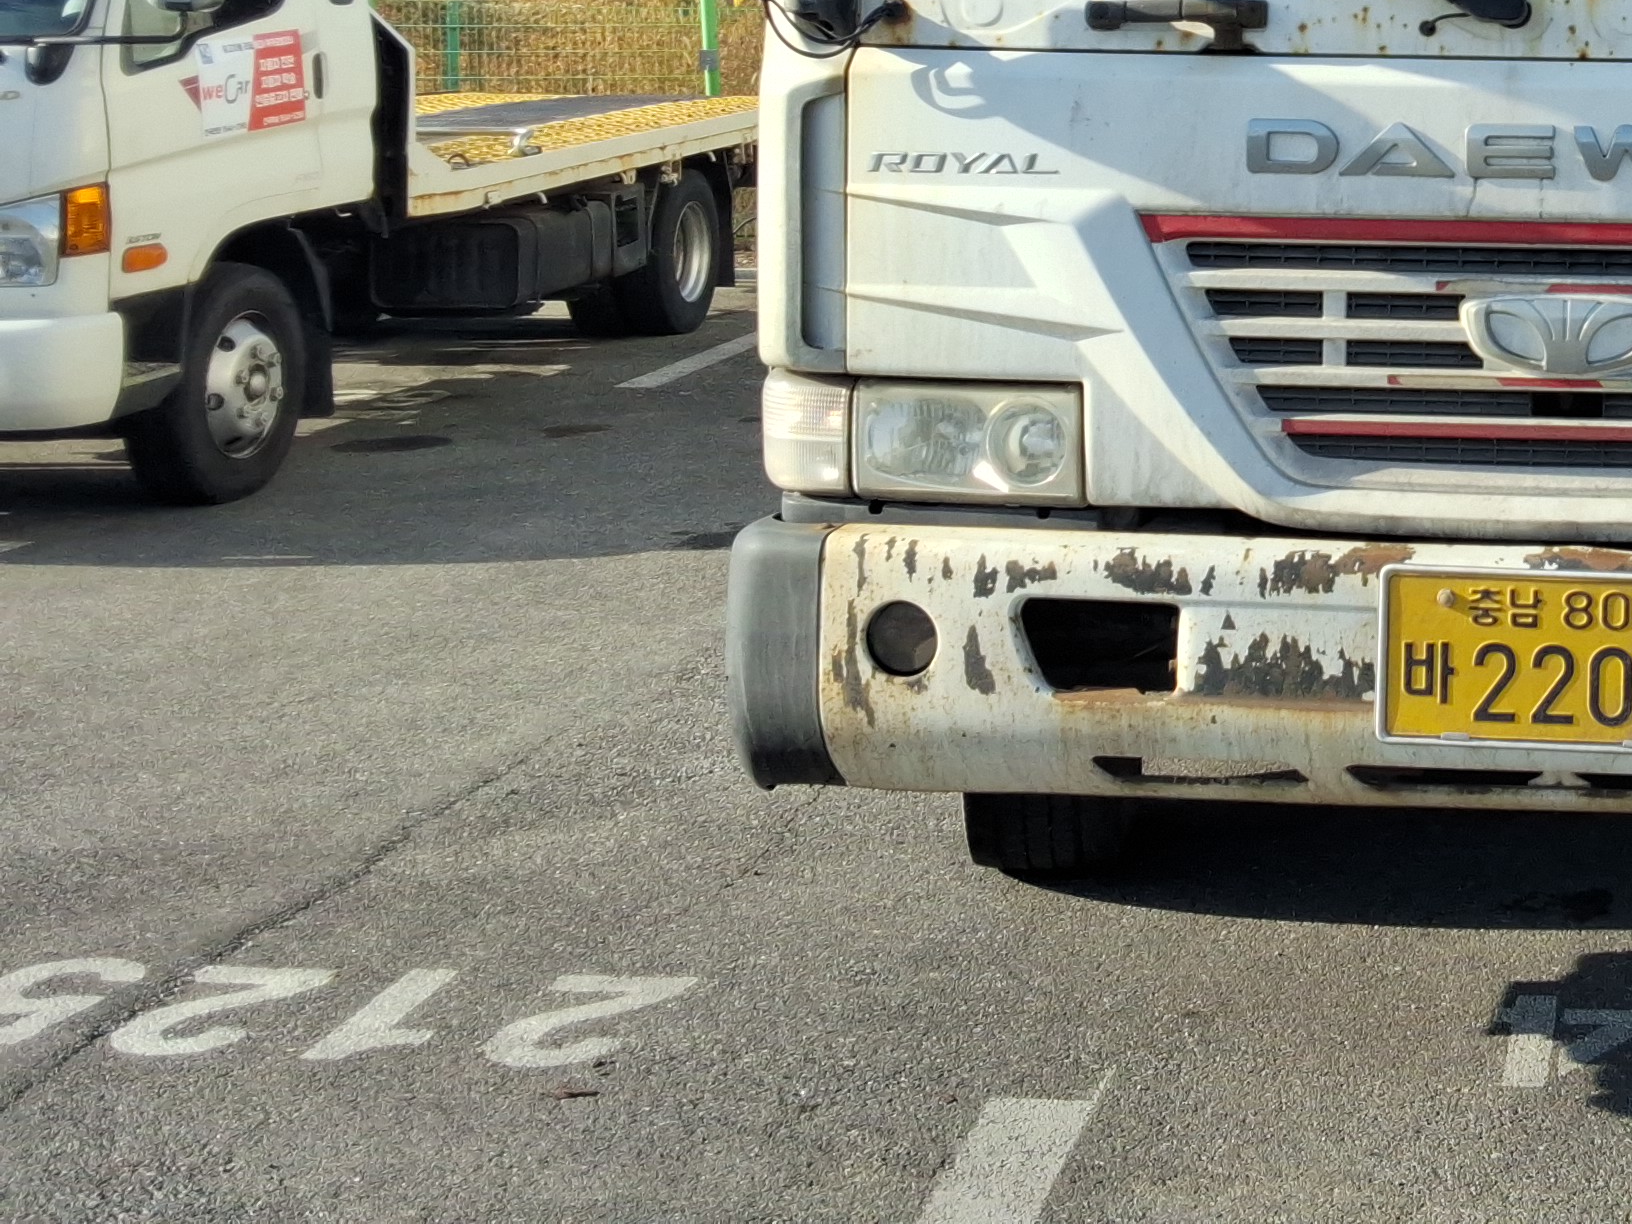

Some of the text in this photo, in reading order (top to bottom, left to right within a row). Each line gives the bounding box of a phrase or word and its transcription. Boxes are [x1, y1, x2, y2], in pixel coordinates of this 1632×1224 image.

[866, 149, 1060, 176] ROYAL
[1467, 587, 1632, 632] 충남 80
[1402, 640, 1456, 705] 바
